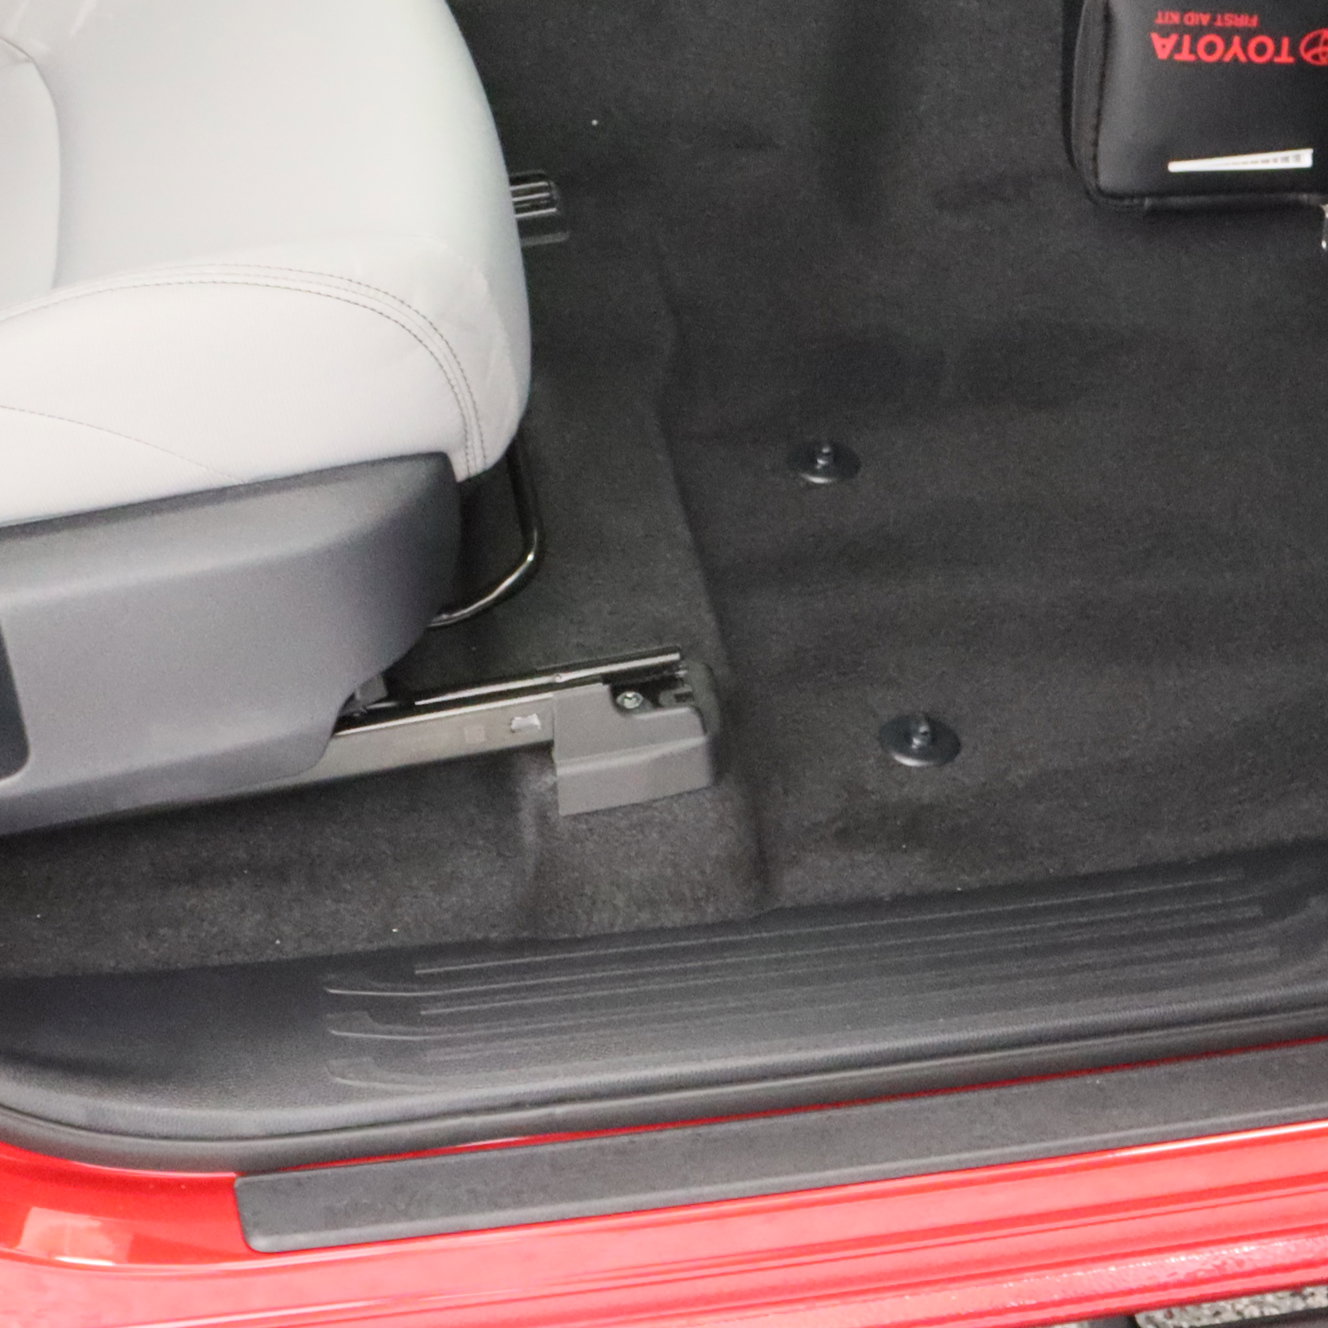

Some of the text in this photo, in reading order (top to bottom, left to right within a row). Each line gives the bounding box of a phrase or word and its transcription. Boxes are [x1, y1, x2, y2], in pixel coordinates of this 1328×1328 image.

[1154, 9, 1260, 28] FIRST AID KIT
[1150, 32, 1296, 64] TOYOTA
